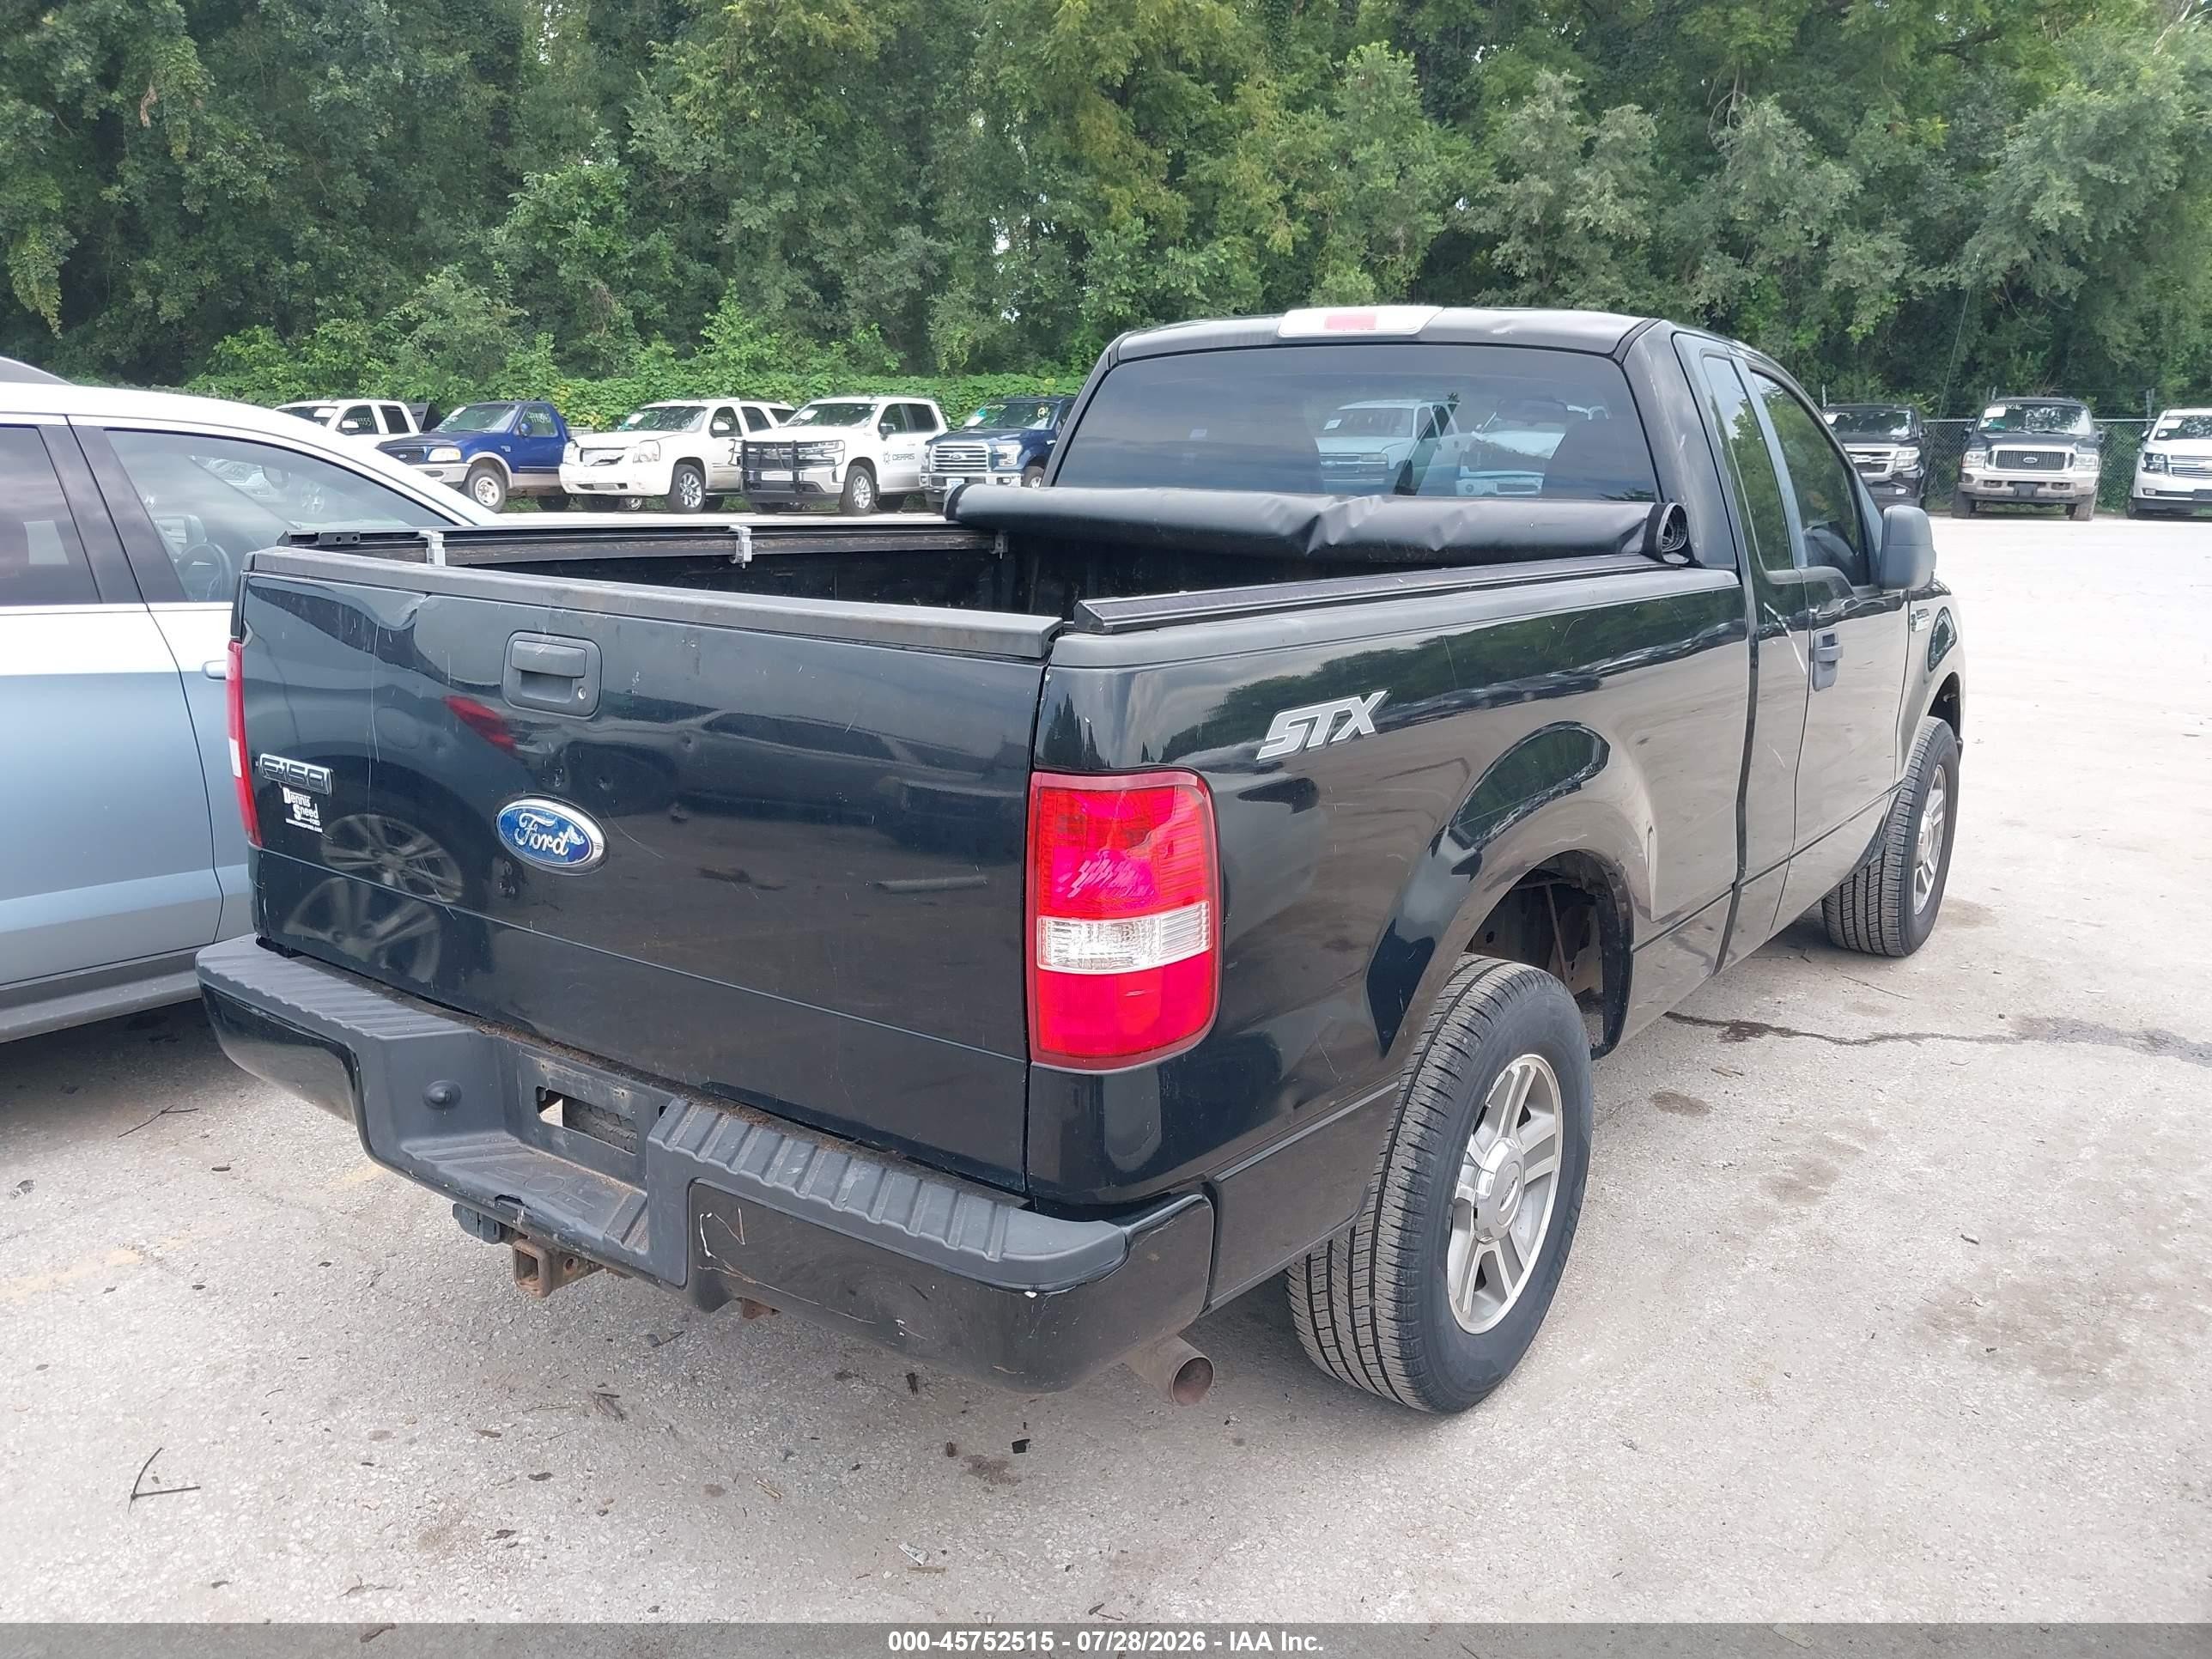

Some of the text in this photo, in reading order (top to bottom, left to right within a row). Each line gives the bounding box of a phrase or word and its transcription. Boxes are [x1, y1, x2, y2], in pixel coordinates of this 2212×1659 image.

[1255, 690, 1389, 761] STX
[282, 787, 312, 807] Dennis
[292, 803, 319, 820] Sneed
